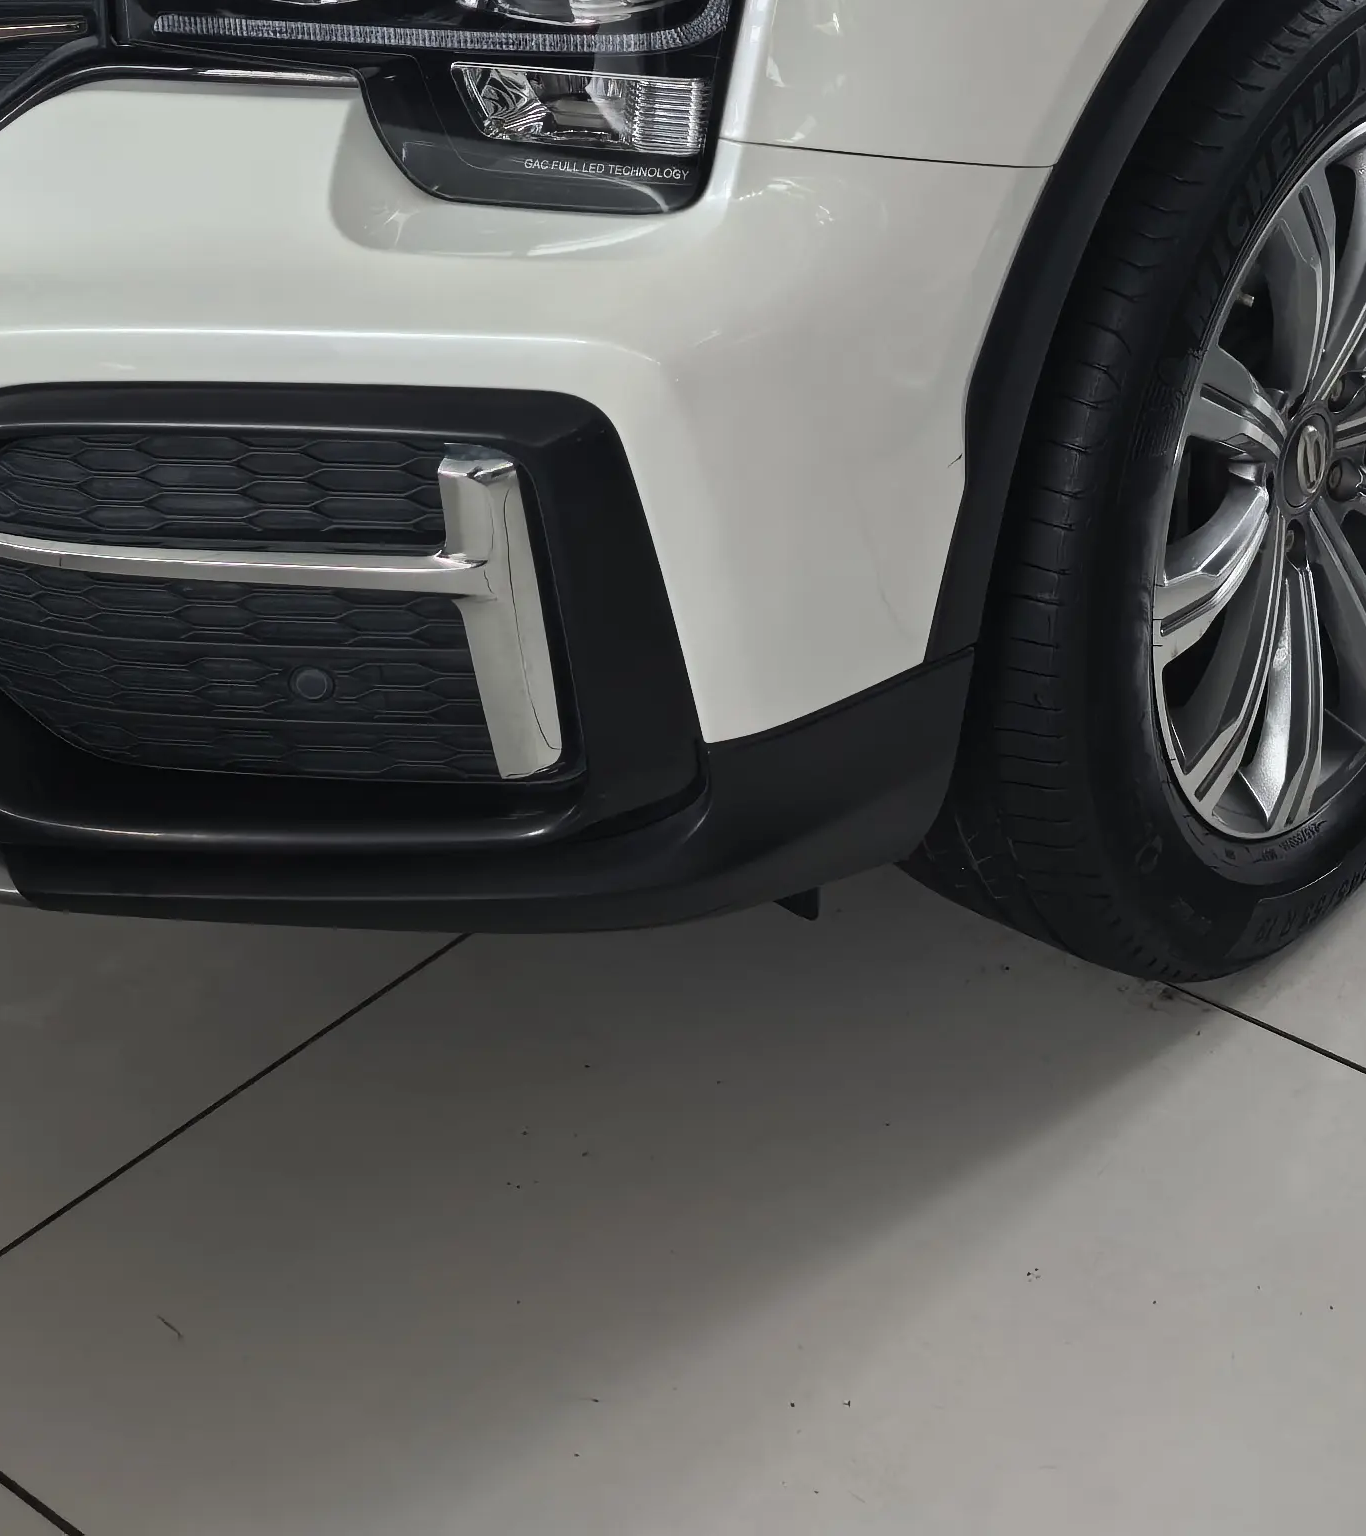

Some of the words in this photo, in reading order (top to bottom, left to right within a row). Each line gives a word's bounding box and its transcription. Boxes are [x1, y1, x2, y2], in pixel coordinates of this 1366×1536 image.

[524, 158, 550, 170] GAC
[551, 160, 580, 173] FULL
[582, 162, 606, 175] LED
[608, 164, 690, 181] TECHNOLOGY
